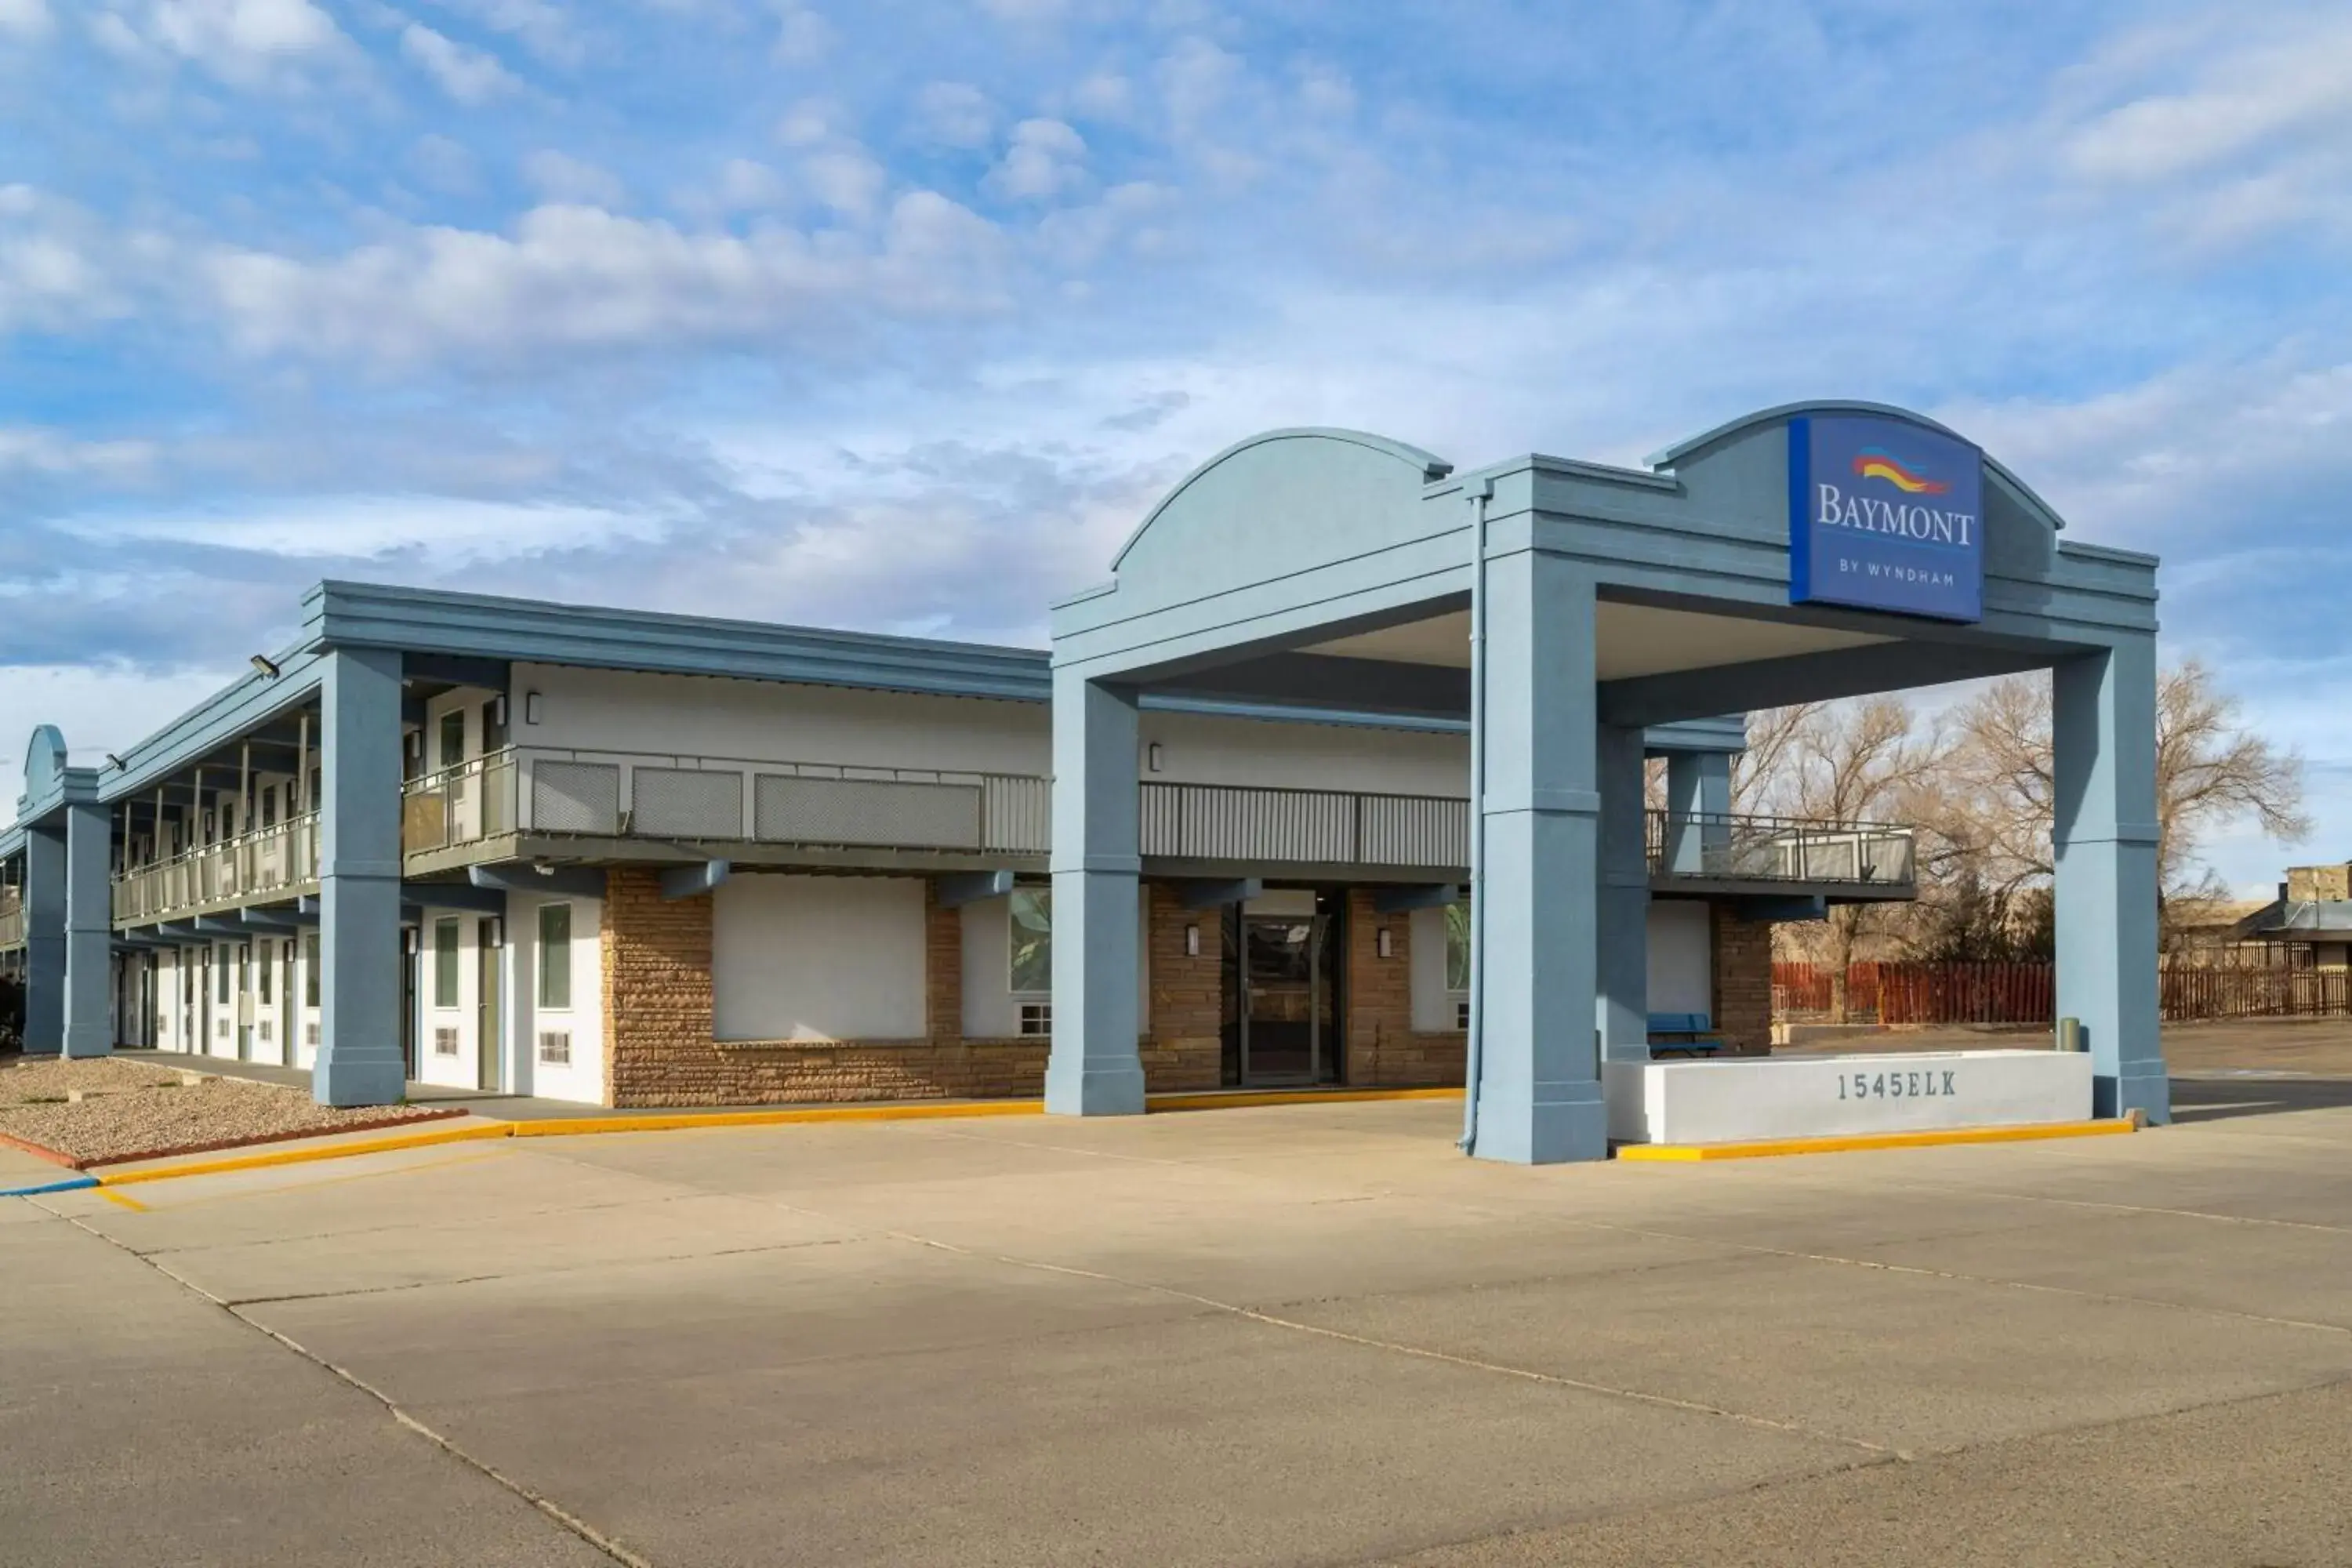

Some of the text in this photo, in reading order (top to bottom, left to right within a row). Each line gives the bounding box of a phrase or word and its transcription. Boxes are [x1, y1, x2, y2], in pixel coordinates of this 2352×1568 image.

[1817, 483, 1976, 546] BAYMONT
[1839, 557, 1955, 587] BY WYNDHAM
